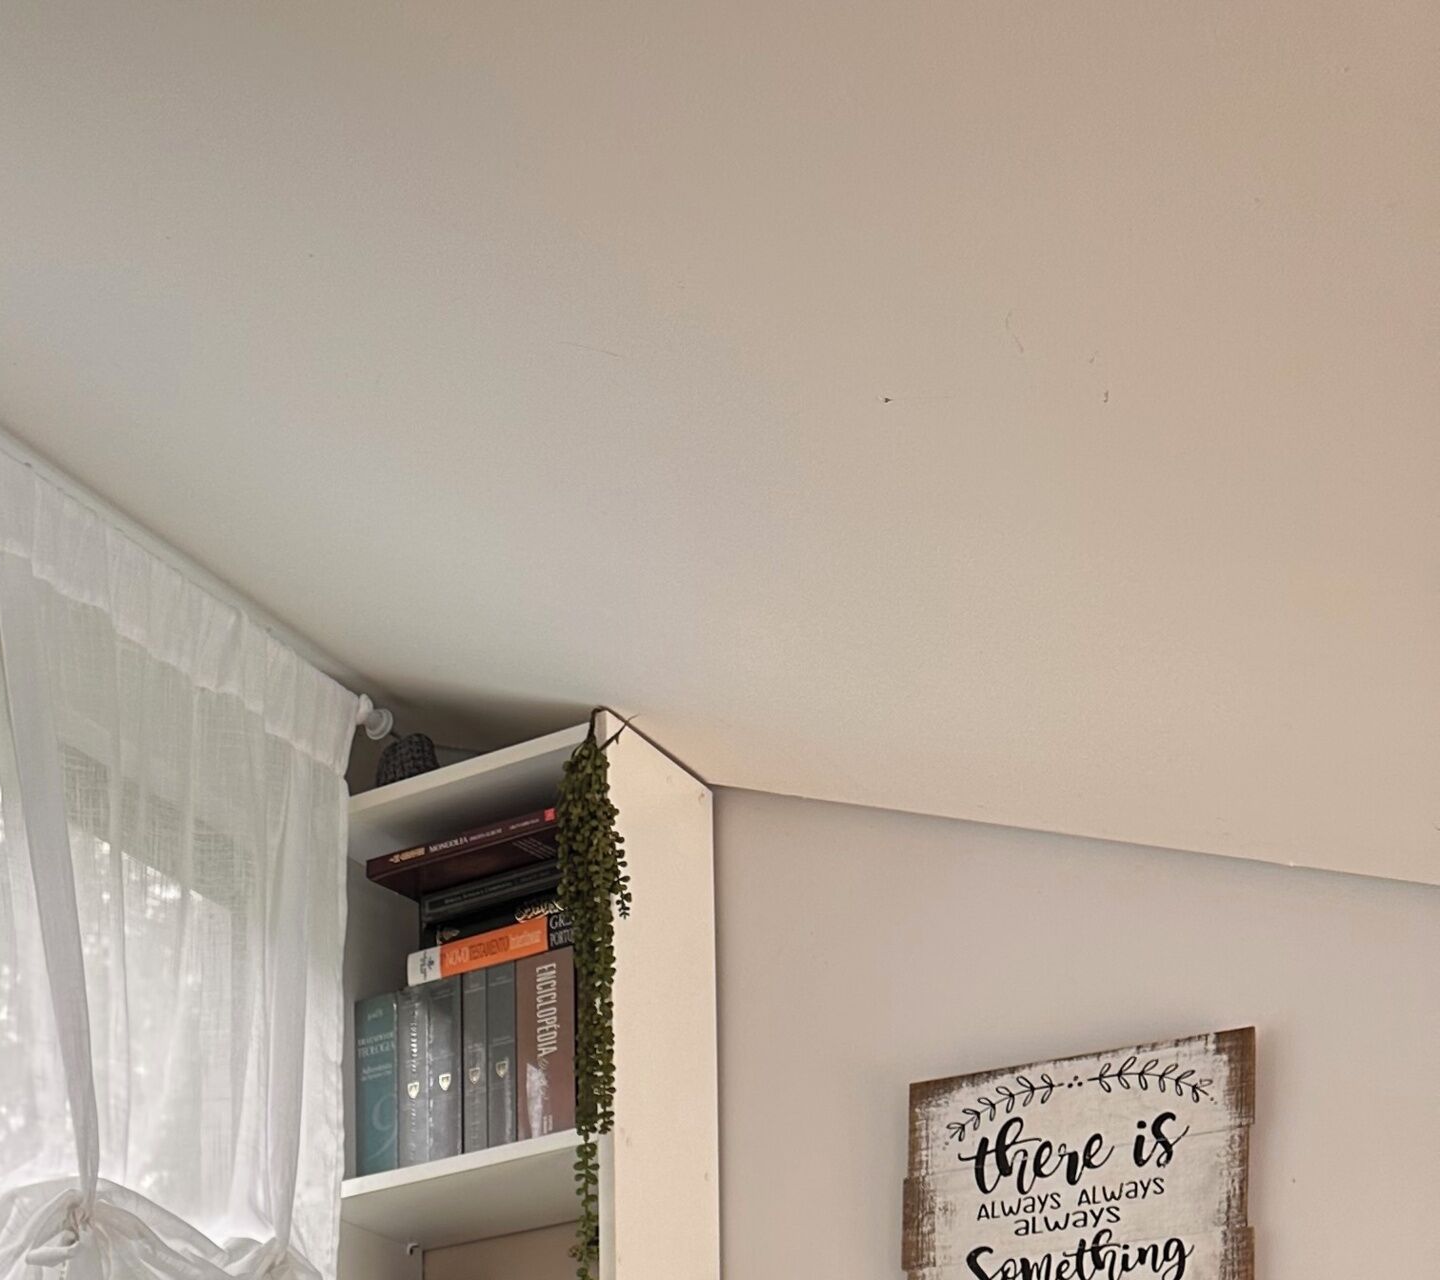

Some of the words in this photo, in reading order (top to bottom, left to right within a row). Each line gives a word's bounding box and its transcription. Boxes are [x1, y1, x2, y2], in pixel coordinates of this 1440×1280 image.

[536, 963, 560, 1057] ENCICLOPÉDIA
[958, 1117, 1115, 1194] there
[1133, 1112, 1189, 1169] is
